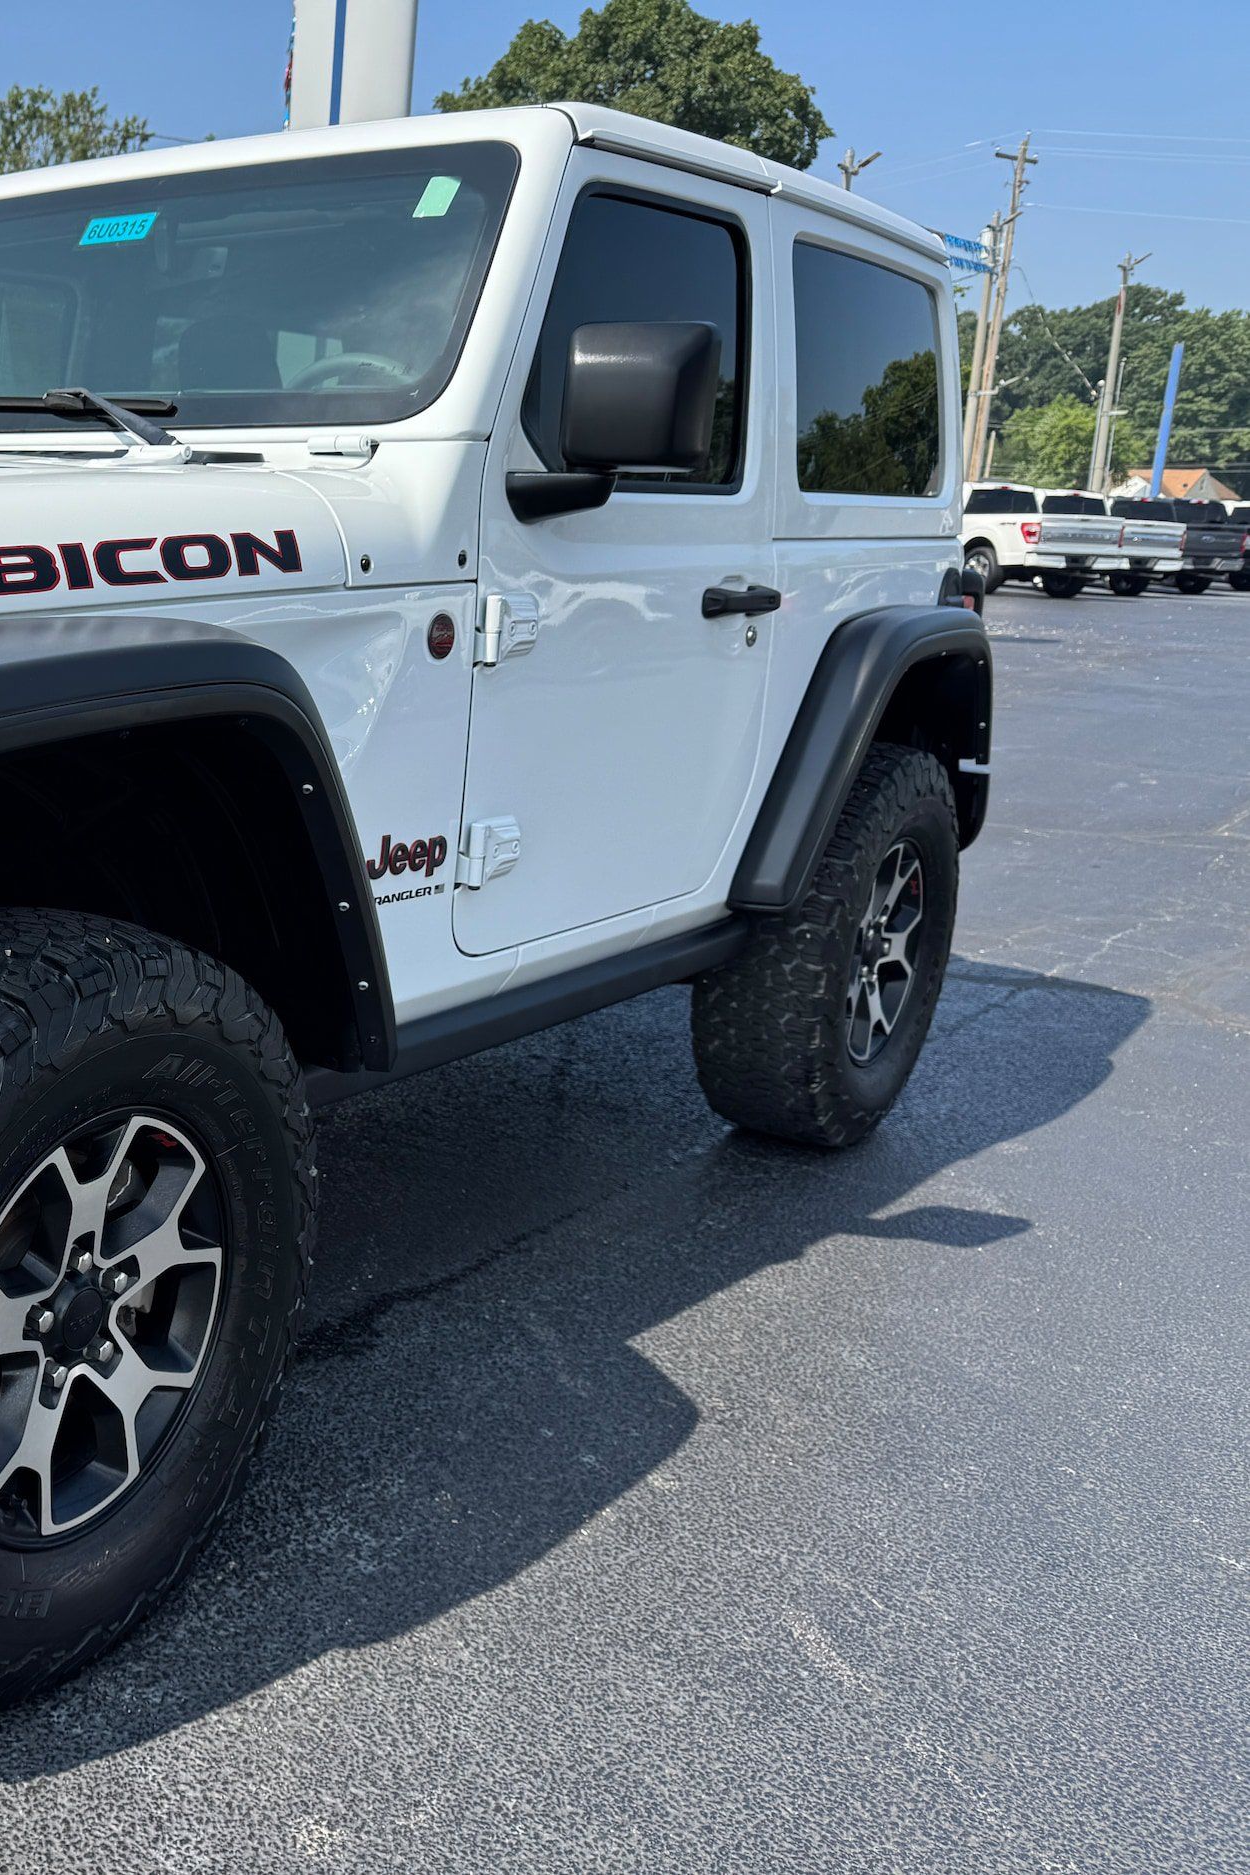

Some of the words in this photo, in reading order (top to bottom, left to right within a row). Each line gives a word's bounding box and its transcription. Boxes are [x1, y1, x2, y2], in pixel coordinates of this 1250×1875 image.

[87, 219, 149, 240] 6U0315
[366, 834, 448, 880] Jeep
[374, 886, 432, 906] RANGLER
